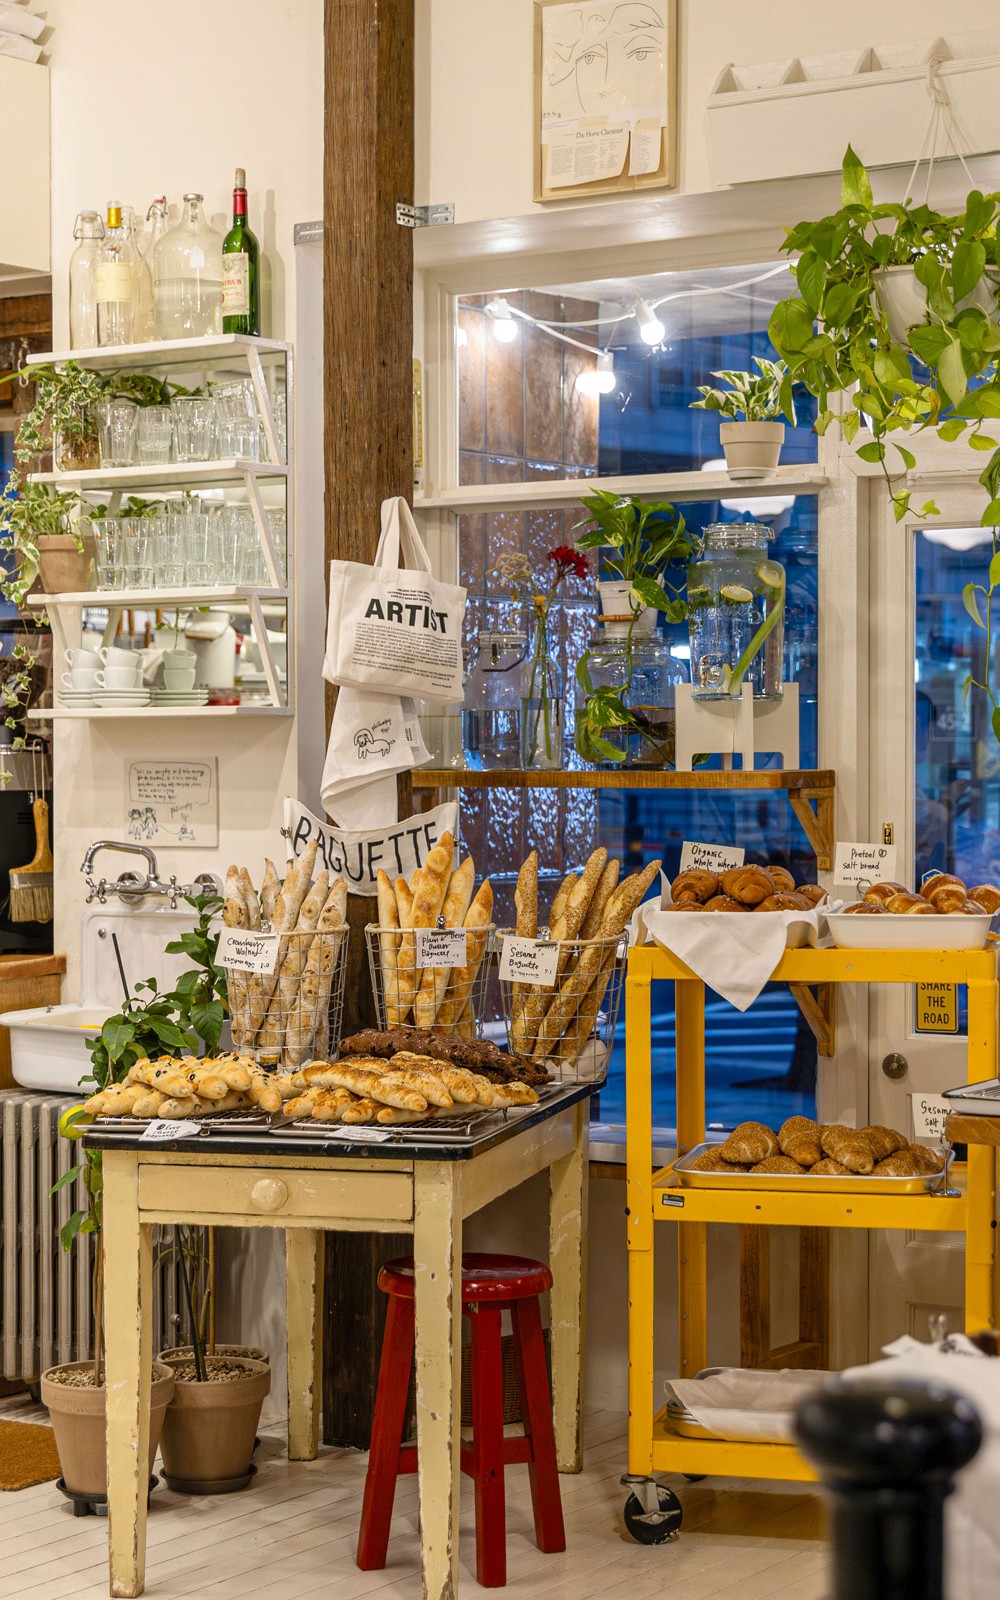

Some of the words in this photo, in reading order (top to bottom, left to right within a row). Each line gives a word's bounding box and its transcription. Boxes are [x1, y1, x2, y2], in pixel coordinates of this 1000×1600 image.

[364, 598, 448, 634] ARTIST
[293, 816, 437, 882] BAGUETTE
[691, 845, 722, 858] Organic
[851, 848, 875, 860] Pretzel
[860, 861, 880, 870] bread
[510, 946, 537, 959] Sesame
[509, 959, 539, 970] Baguette
[920, 983, 952, 991] SHARE
[927, 996, 946, 1008] THE
[923, 1012, 950, 1025] ROAD
